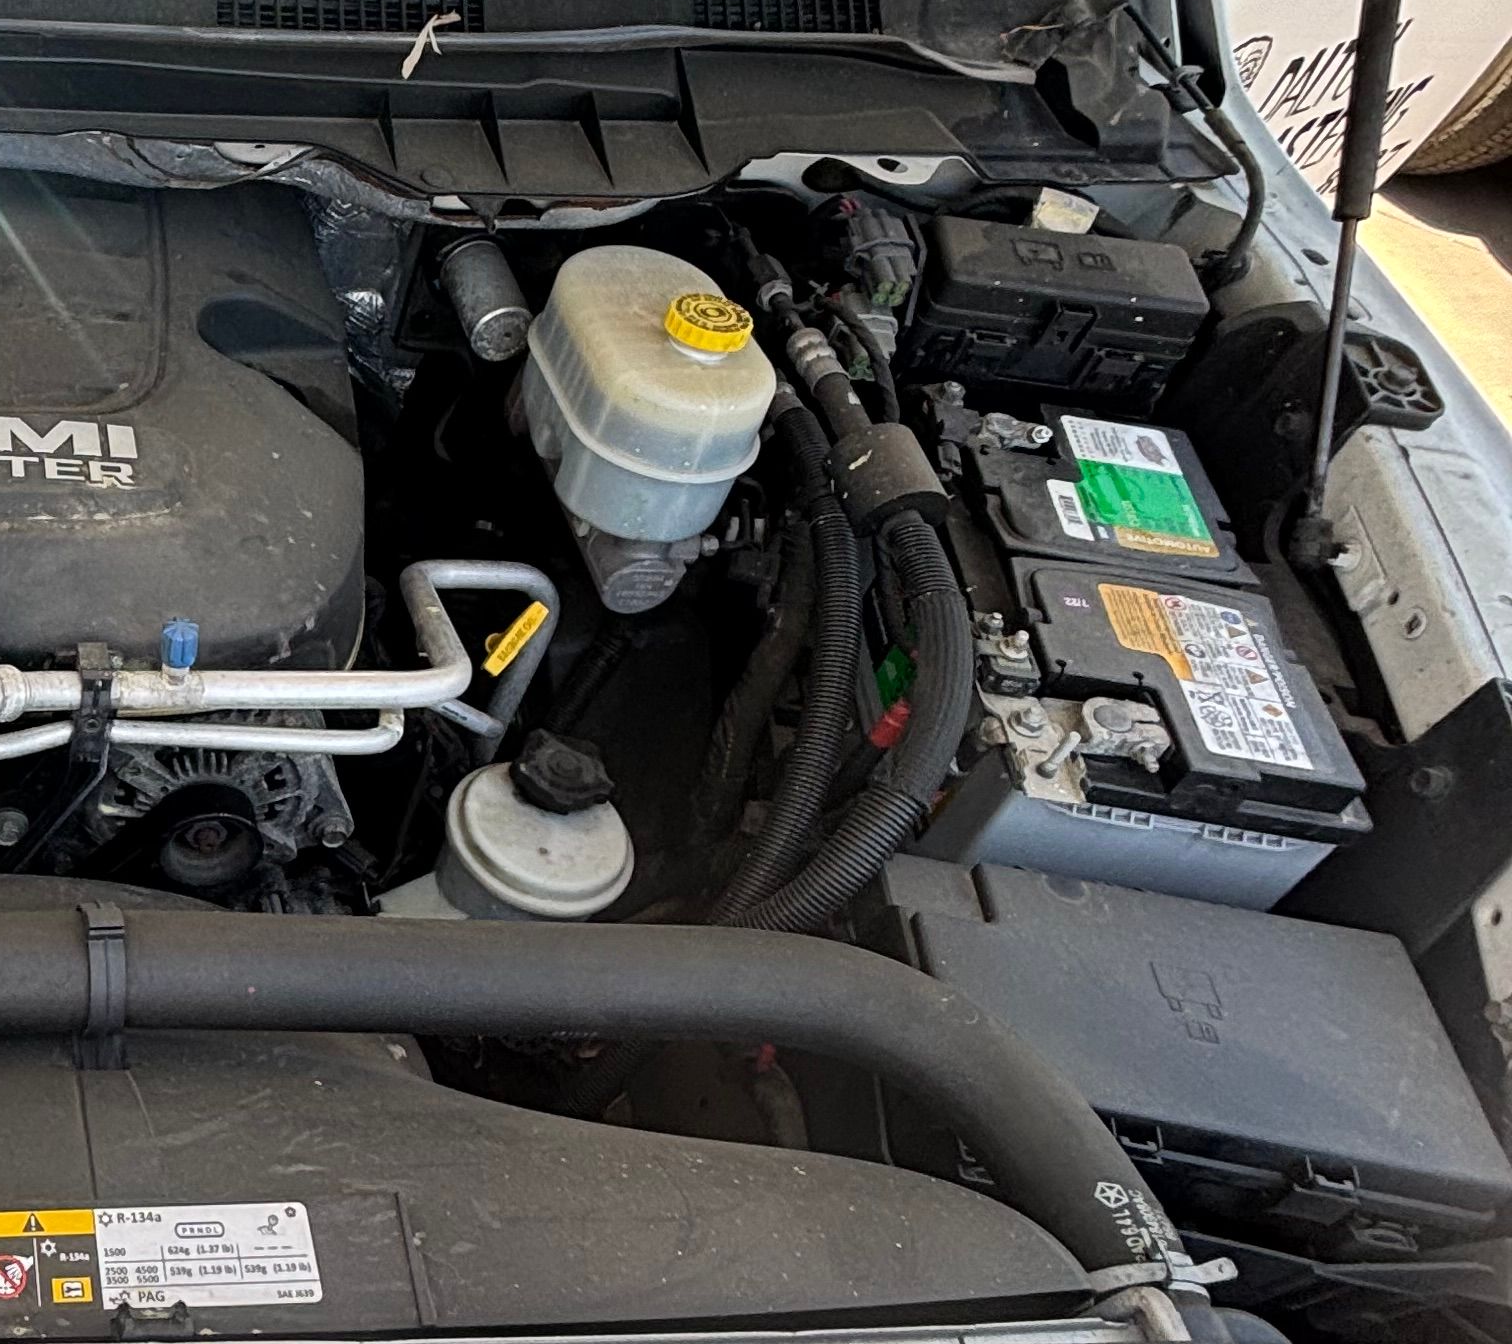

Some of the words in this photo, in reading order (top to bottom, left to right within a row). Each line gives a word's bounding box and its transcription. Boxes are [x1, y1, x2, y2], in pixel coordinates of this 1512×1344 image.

[116, 1211, 162, 1224] R-134a
[103, 1247, 126, 1257] 1500
[105, 1266, 129, 1276] 2500
[134, 1265, 159, 1275] 4500
[106, 1275, 129, 1284] 3500
[136, 1274, 160, 1283] 5500
[138, 1289, 166, 1303] PAG
